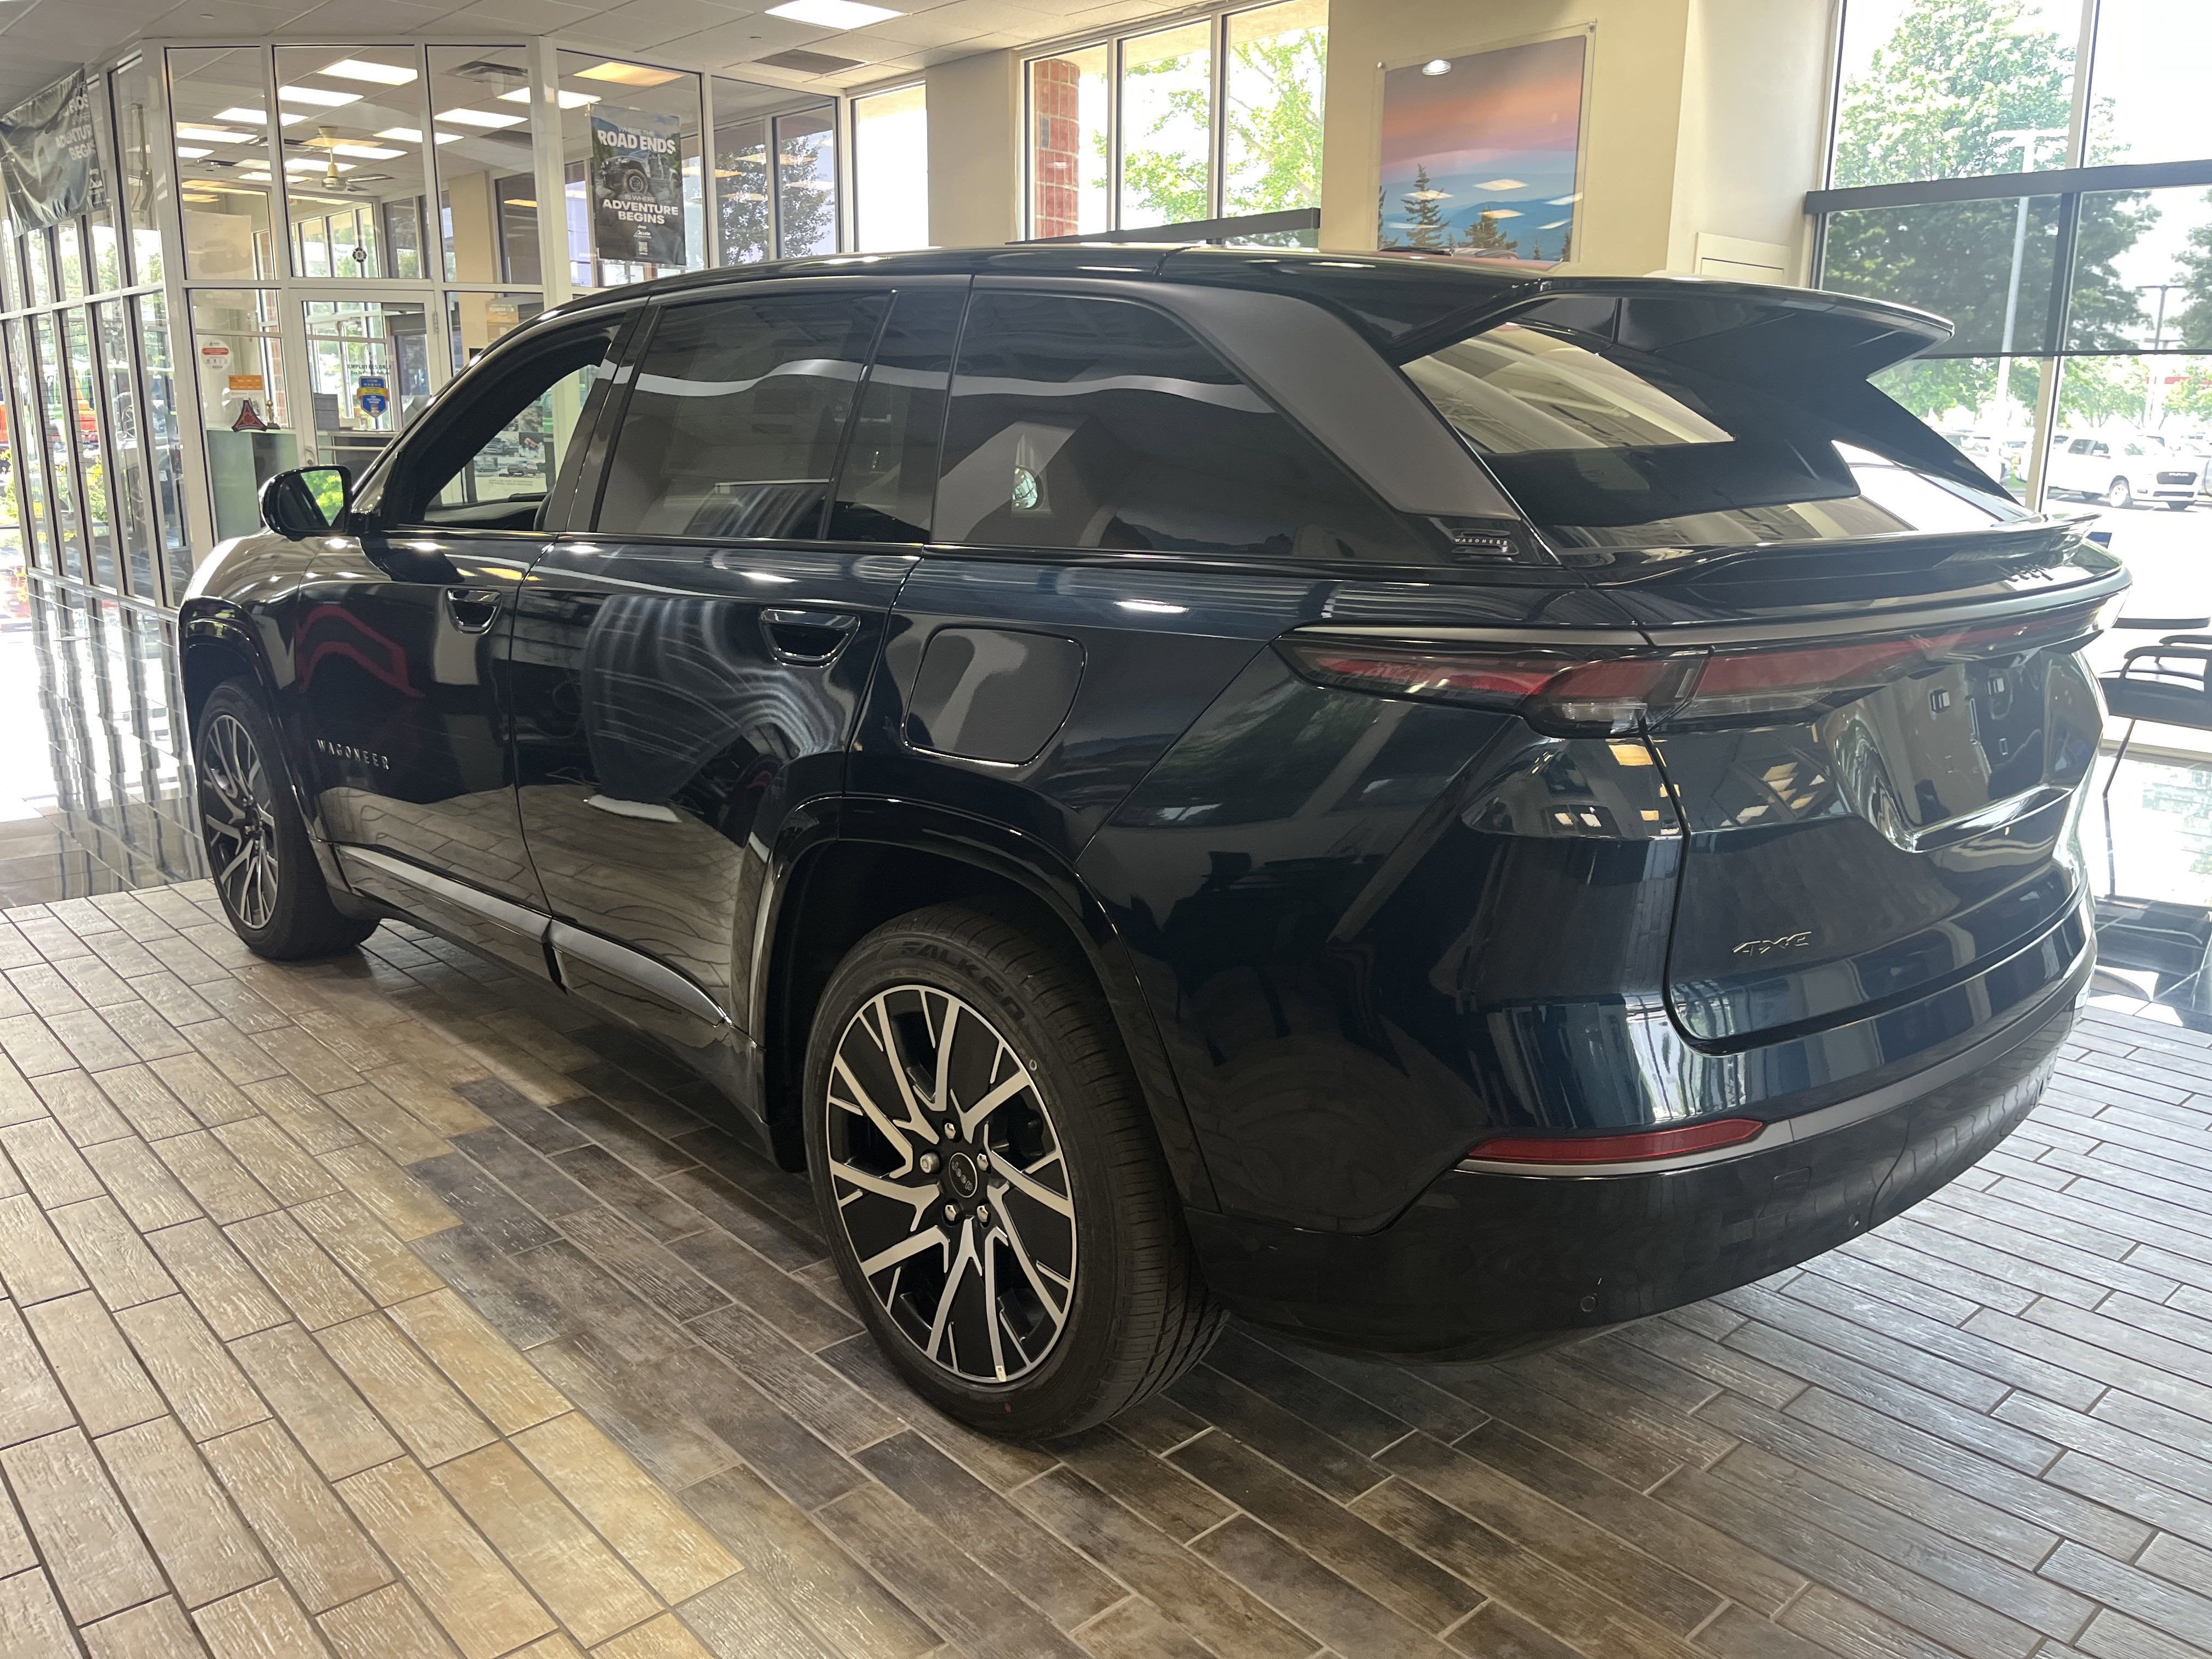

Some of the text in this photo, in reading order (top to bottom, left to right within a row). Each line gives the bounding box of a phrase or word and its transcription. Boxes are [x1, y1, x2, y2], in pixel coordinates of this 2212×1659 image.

[618, 127, 641, 136] WHERE
[597, 130, 676, 155] ROAD ENDS
[602, 199, 679, 216] ADVENTURE
[618, 211, 665, 224] BEGINS
[317, 739, 390, 770] WAGONEER
[951, 1161, 973, 1190] Jeep
